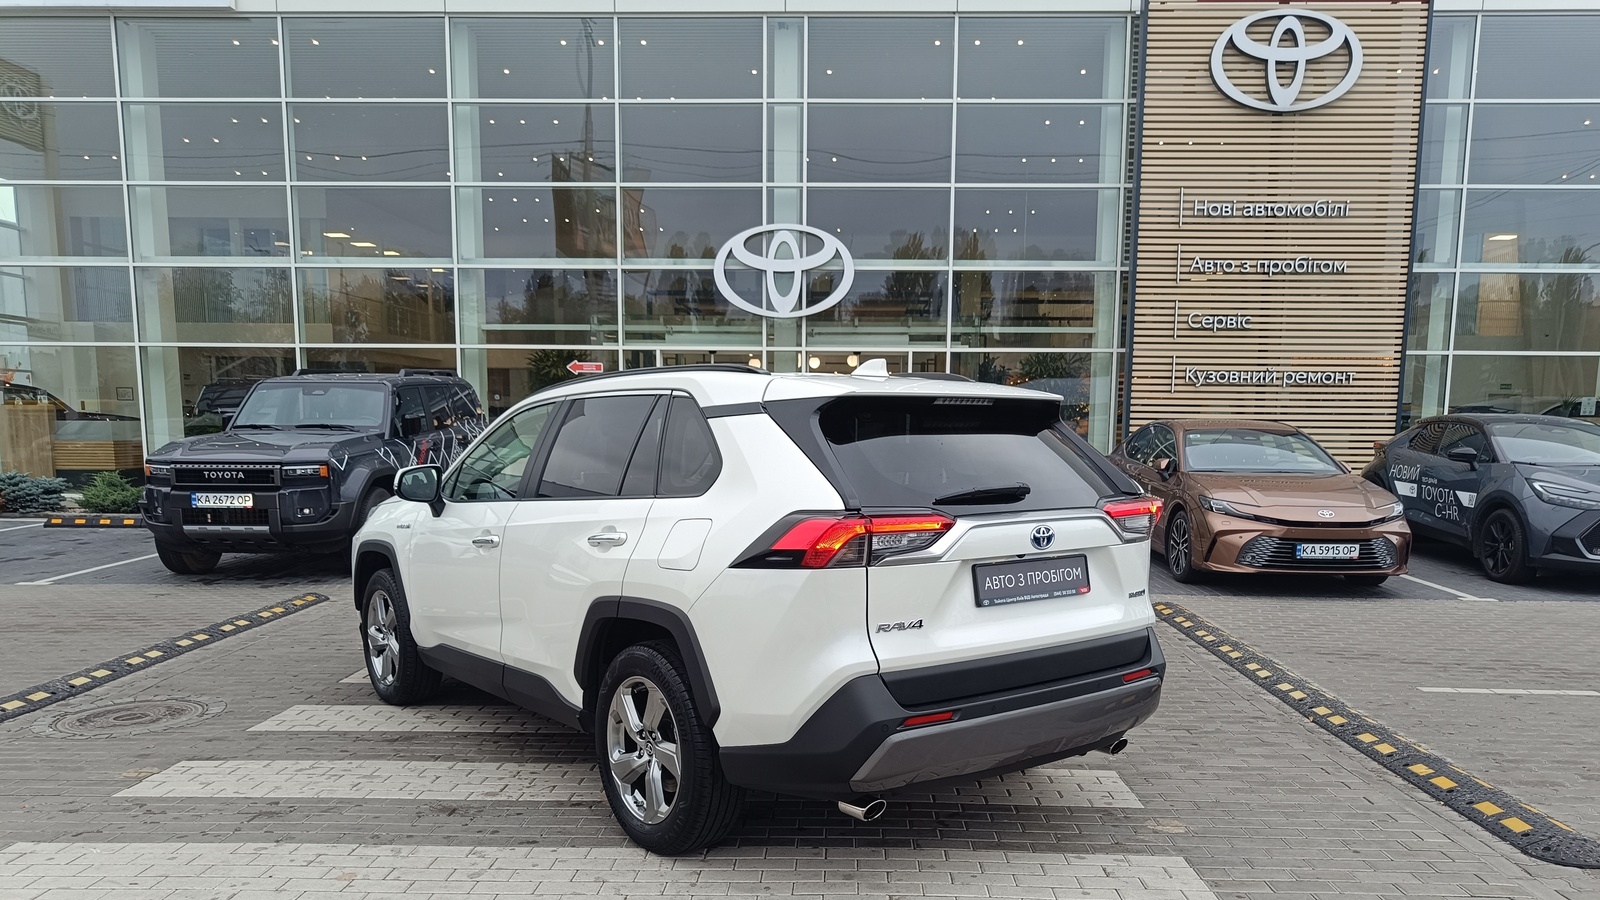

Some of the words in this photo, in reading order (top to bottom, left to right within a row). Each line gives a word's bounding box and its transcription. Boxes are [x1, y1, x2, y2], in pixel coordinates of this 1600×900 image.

[1193, 199, 1237, 217] Нові
[1242, 199, 1350, 218] автомобілі
[1190, 256, 1235, 274] Авто
[1240, 259, 1250, 273] з
[1256, 256, 1348, 277] пробігом
[1187, 312, 1253, 333] Сервіс
[1185, 366, 1277, 387] Кузовний
[1282, 370, 1356, 388] ремонт
[203, 471, 245, 479] TOYOTA
[1389, 464, 1421, 480] НОВИЙ
[197, 495, 211, 505] KA
[212, 495, 236, 505] 2672
[237, 495, 251, 505] OP
[1421, 484, 1455, 505] TOYOTA
[1434, 503, 1460, 521] C-HR
[1302, 545, 1316, 556] KA
[1318, 545, 1340, 556] 5915
[1342, 545, 1357, 556] OP
[984, 574, 1015, 590] АВТО
[1027, 567, 1082, 585] ПРОБІГОМ
[875, 618, 923, 633] RAV4
